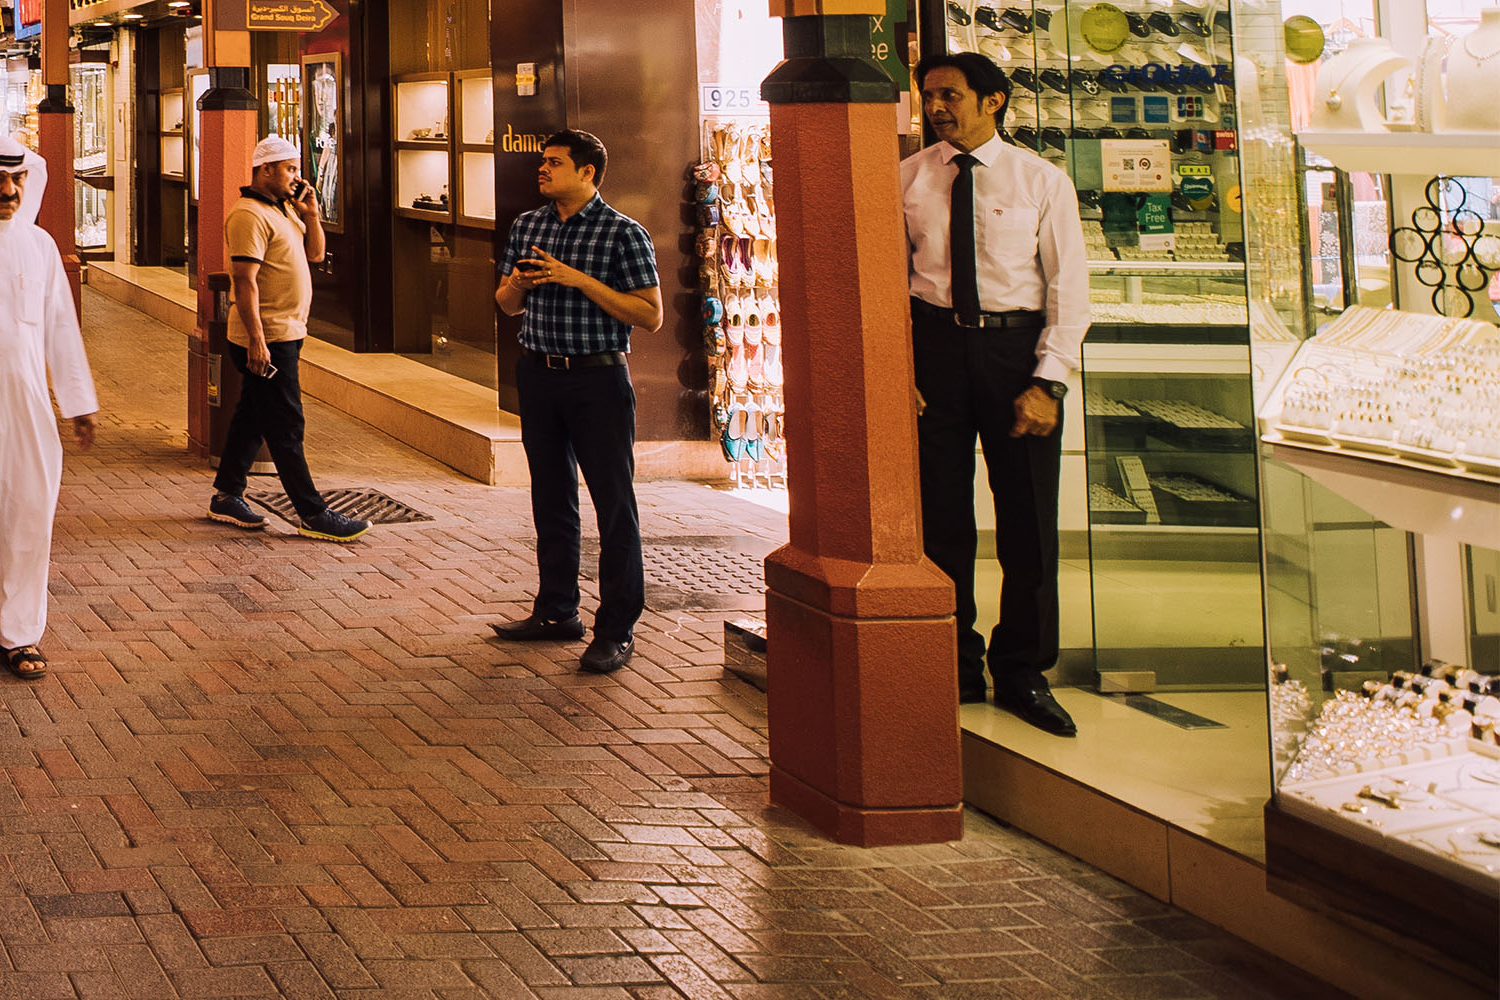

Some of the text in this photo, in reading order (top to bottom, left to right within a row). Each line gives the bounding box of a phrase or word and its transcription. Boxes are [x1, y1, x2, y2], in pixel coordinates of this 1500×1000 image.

[251, 13, 317, 22] Grand Souq Deira
[710, 89, 750, 108] 925
[502, 123, 555, 153] dama
[1147, 202, 1162, 212] Tax
[1145, 213, 1166, 223] Free
